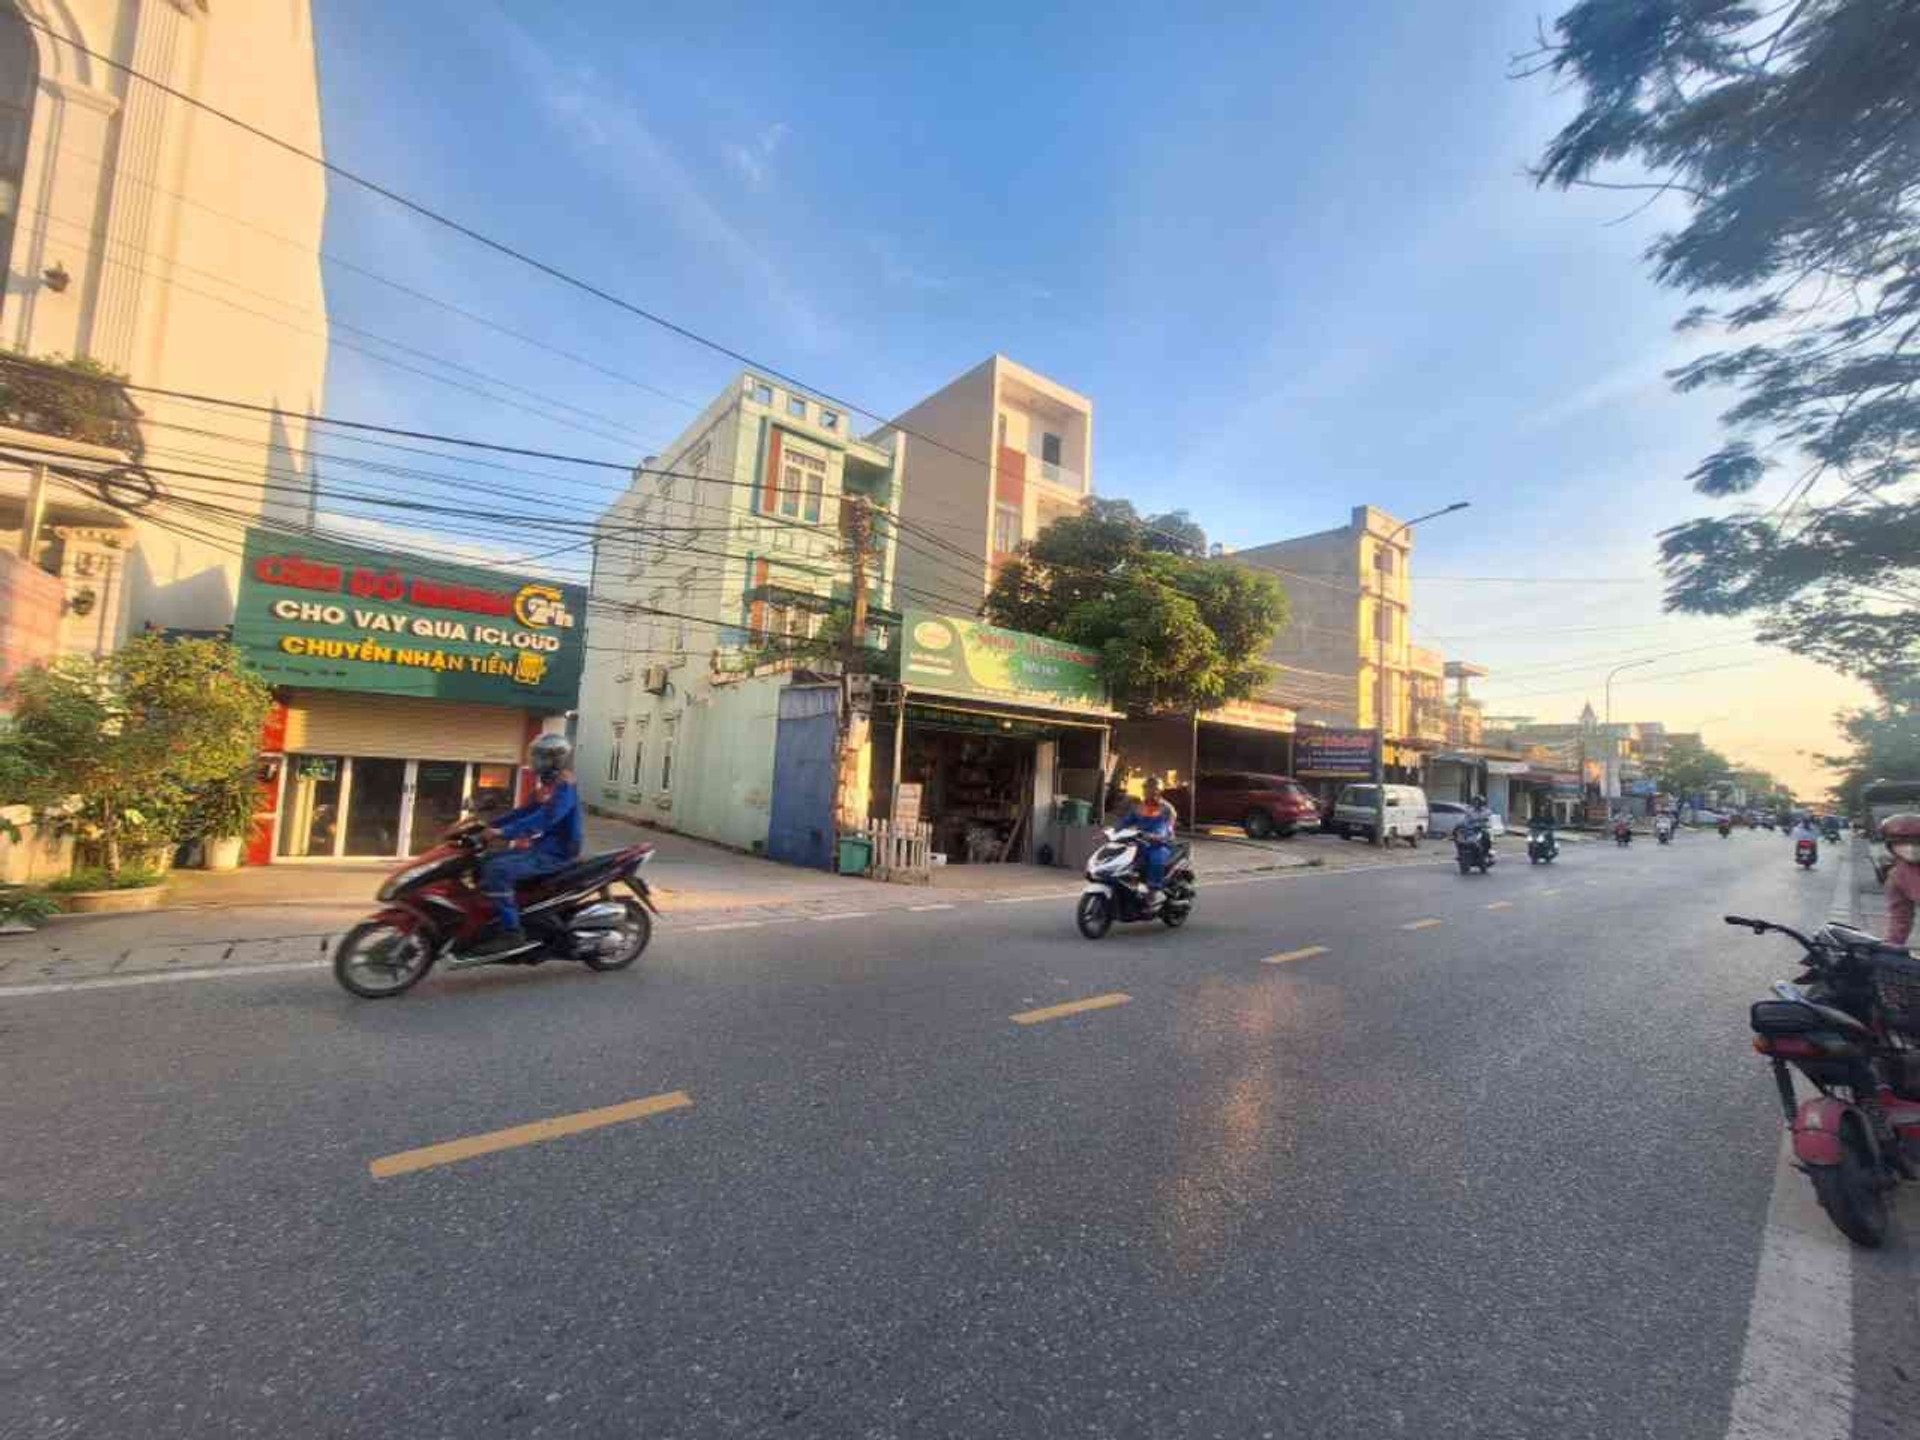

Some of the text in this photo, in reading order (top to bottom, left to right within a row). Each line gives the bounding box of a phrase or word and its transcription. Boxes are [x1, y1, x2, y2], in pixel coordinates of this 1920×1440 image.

[275, 599, 560, 651] CHO VAY QUA ICLOUD
[396, 650, 464, 673] NHẬN
